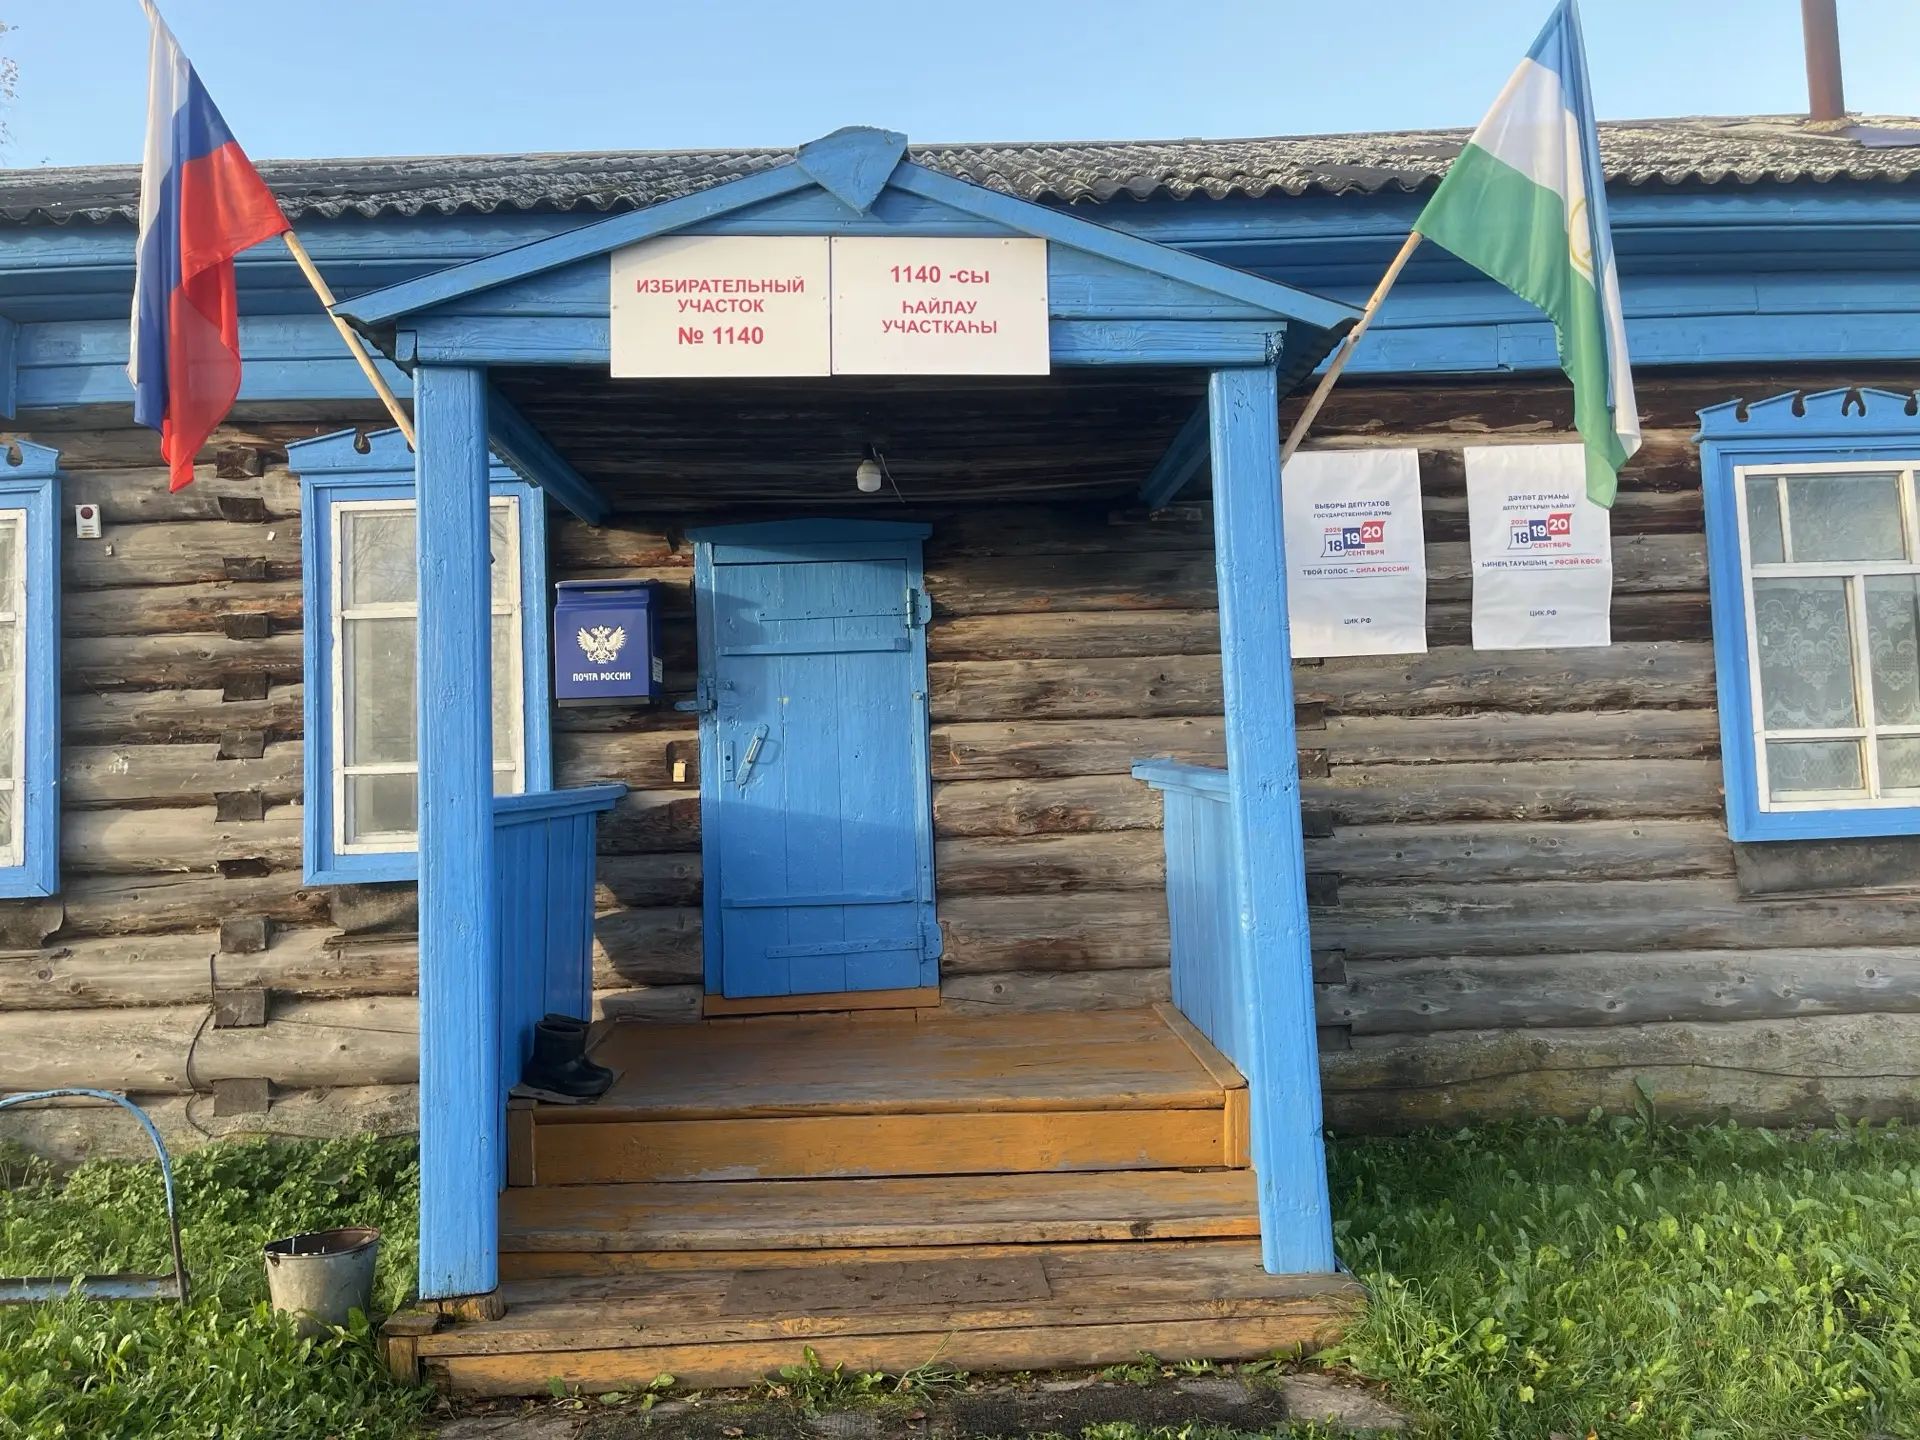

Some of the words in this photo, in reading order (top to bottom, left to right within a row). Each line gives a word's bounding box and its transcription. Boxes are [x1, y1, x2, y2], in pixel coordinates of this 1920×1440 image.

[890, 265, 941, 284] 1140
[636, 276, 805, 294] ИЗБИРАТЕЛЬНЫЙ
[678, 298, 764, 313] УЧАСТОК
[678, 326, 705, 345] №
[712, 326, 764, 345] 1140
[1313, 510, 1372, 518] ГОСУДАРСТВЕННОЙ
[1549, 518, 1568, 531] 20
[1363, 526, 1382, 539] 20
[1531, 525, 1546, 537] 19
[1345, 533, 1360, 545] 19
[1514, 532, 1529, 544] 18
[1327, 540, 1343, 552] 18
[572, 673, 598, 681] ПОЧТА
[600, 672, 631, 680] РОССИИ
